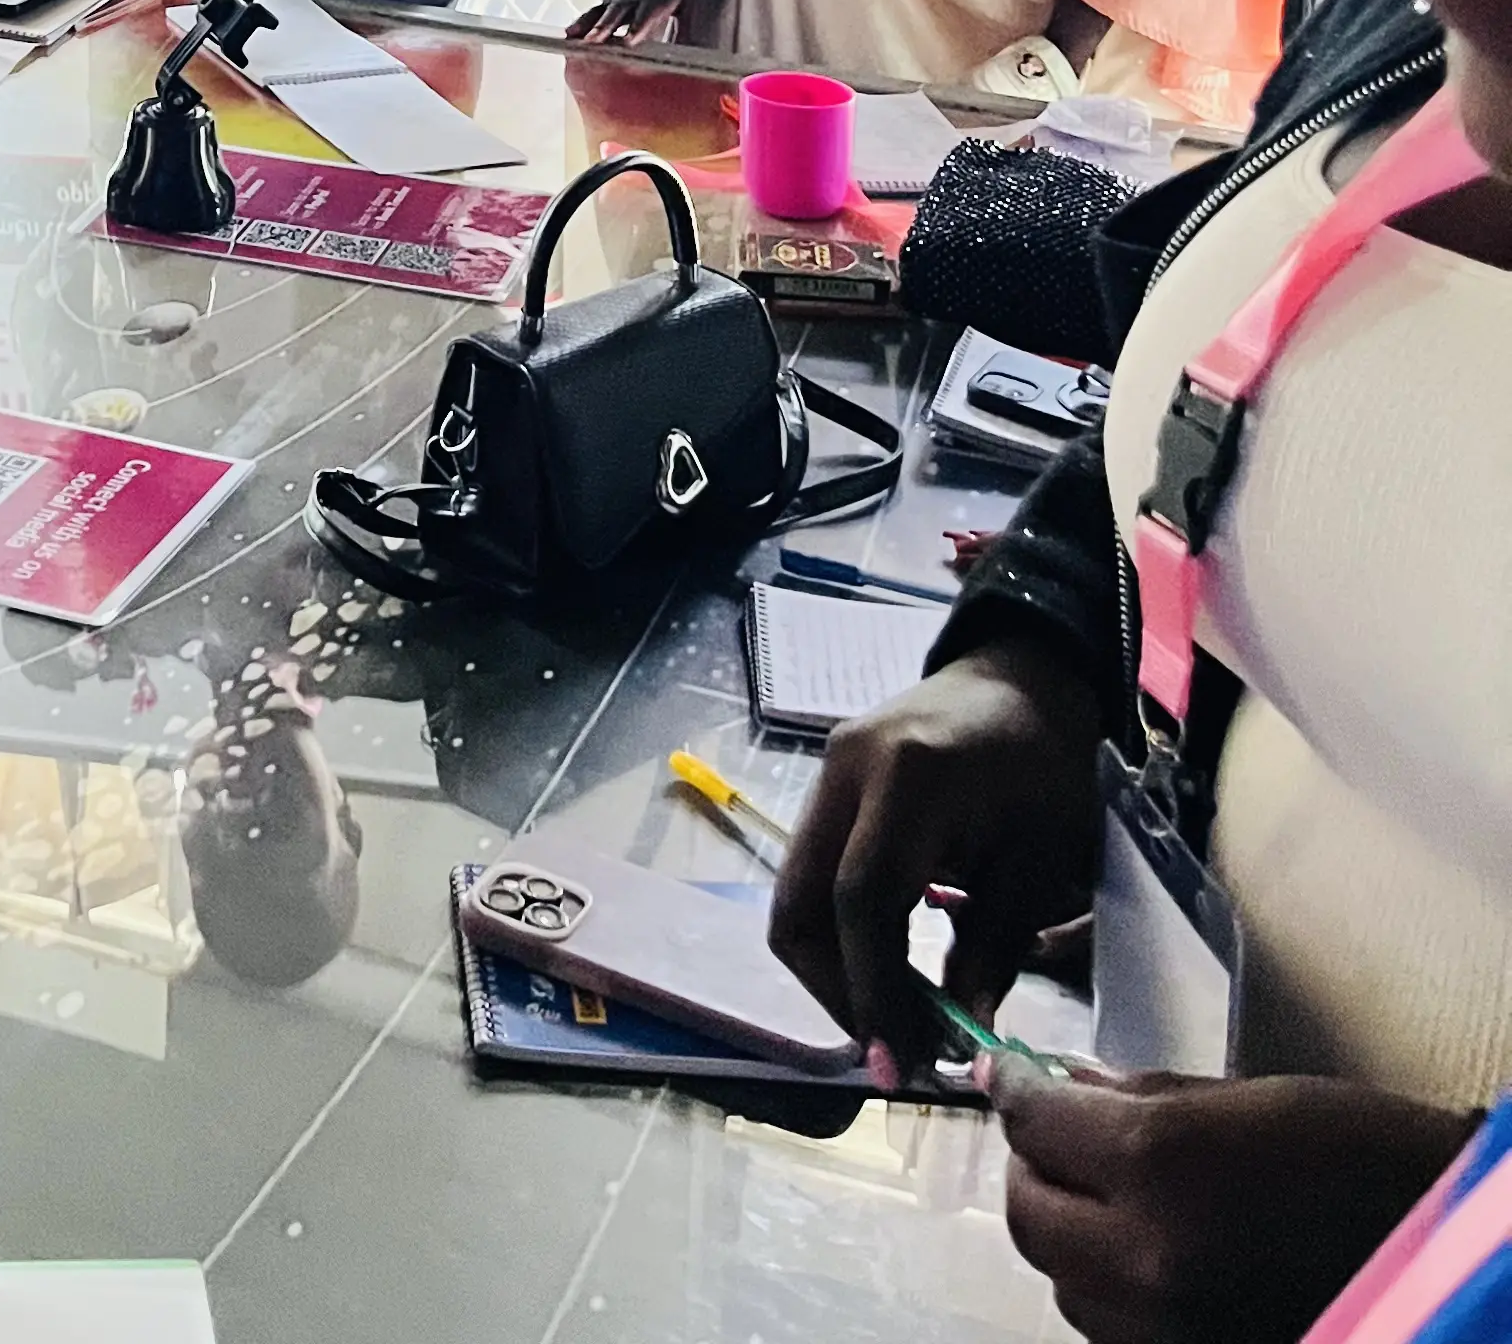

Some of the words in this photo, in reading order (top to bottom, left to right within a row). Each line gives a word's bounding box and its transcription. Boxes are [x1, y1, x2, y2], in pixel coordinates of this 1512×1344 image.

[48, 471, 97, 511] social
[83, 459, 152, 512] Connect
[4, 509, 59, 548] media
[51, 511, 95, 542] with
[34, 541, 62, 559] us
[12, 560, 41, 579] on
